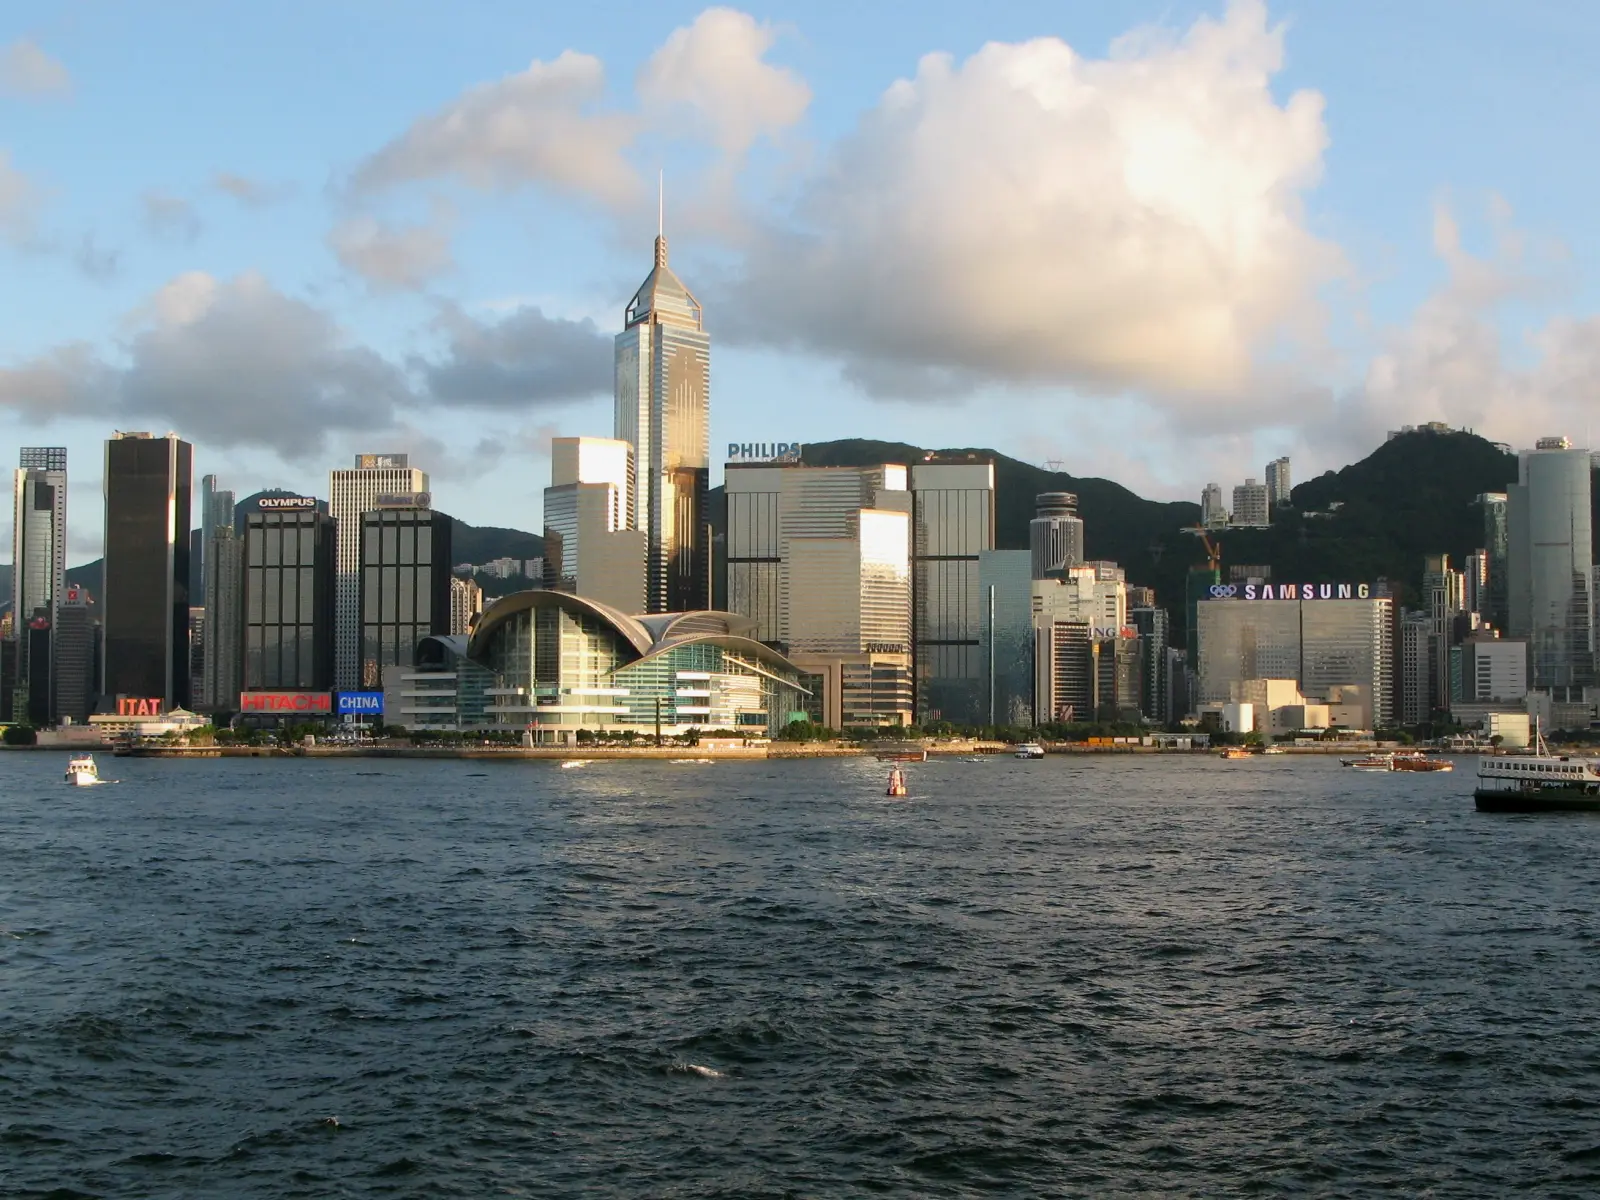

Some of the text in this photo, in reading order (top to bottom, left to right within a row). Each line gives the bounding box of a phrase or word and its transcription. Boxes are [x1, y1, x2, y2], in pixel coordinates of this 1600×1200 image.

[728, 442, 801, 458] PHILIPS
[259, 498, 315, 507] OLYMPUS
[1244, 583, 1369, 599] SAMSUNG
[1088, 627, 1116, 637] ING
[119, 698, 160, 716] ITAT
[242, 694, 330, 710] HITACHI
[340, 696, 379, 708] CHINA
